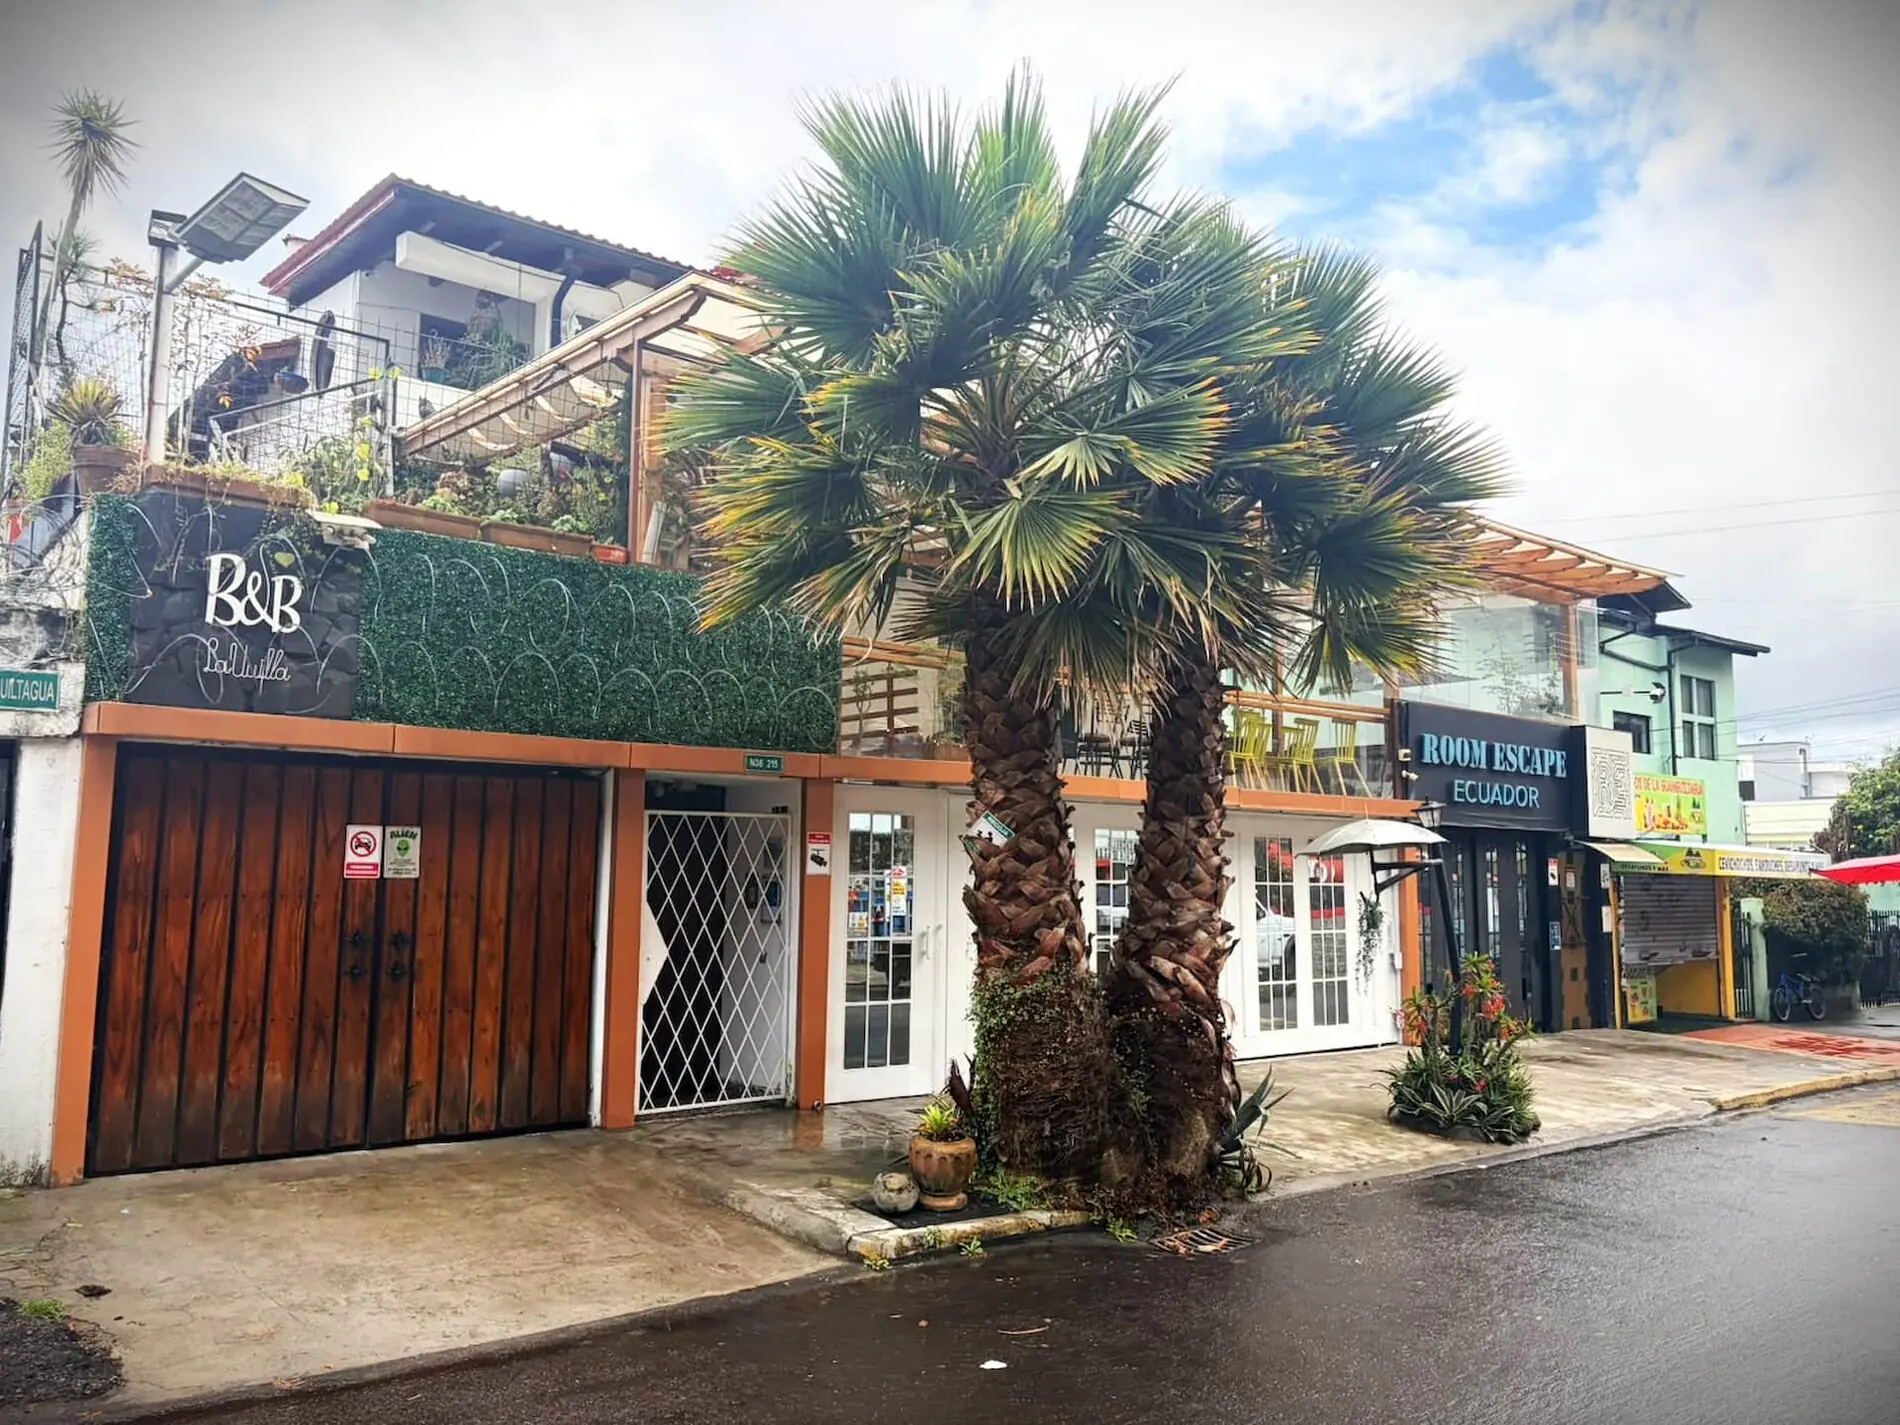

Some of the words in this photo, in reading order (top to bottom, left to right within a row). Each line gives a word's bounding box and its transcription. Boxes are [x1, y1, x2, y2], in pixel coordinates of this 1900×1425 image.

[205, 552, 303, 634] B&B
[1422, 732, 1487, 770] ROOM
[1493, 741, 1567, 778] ESCAPE
[1454, 779, 1540, 809] ECUADOR
[390, 830, 418, 840] ALIEN
